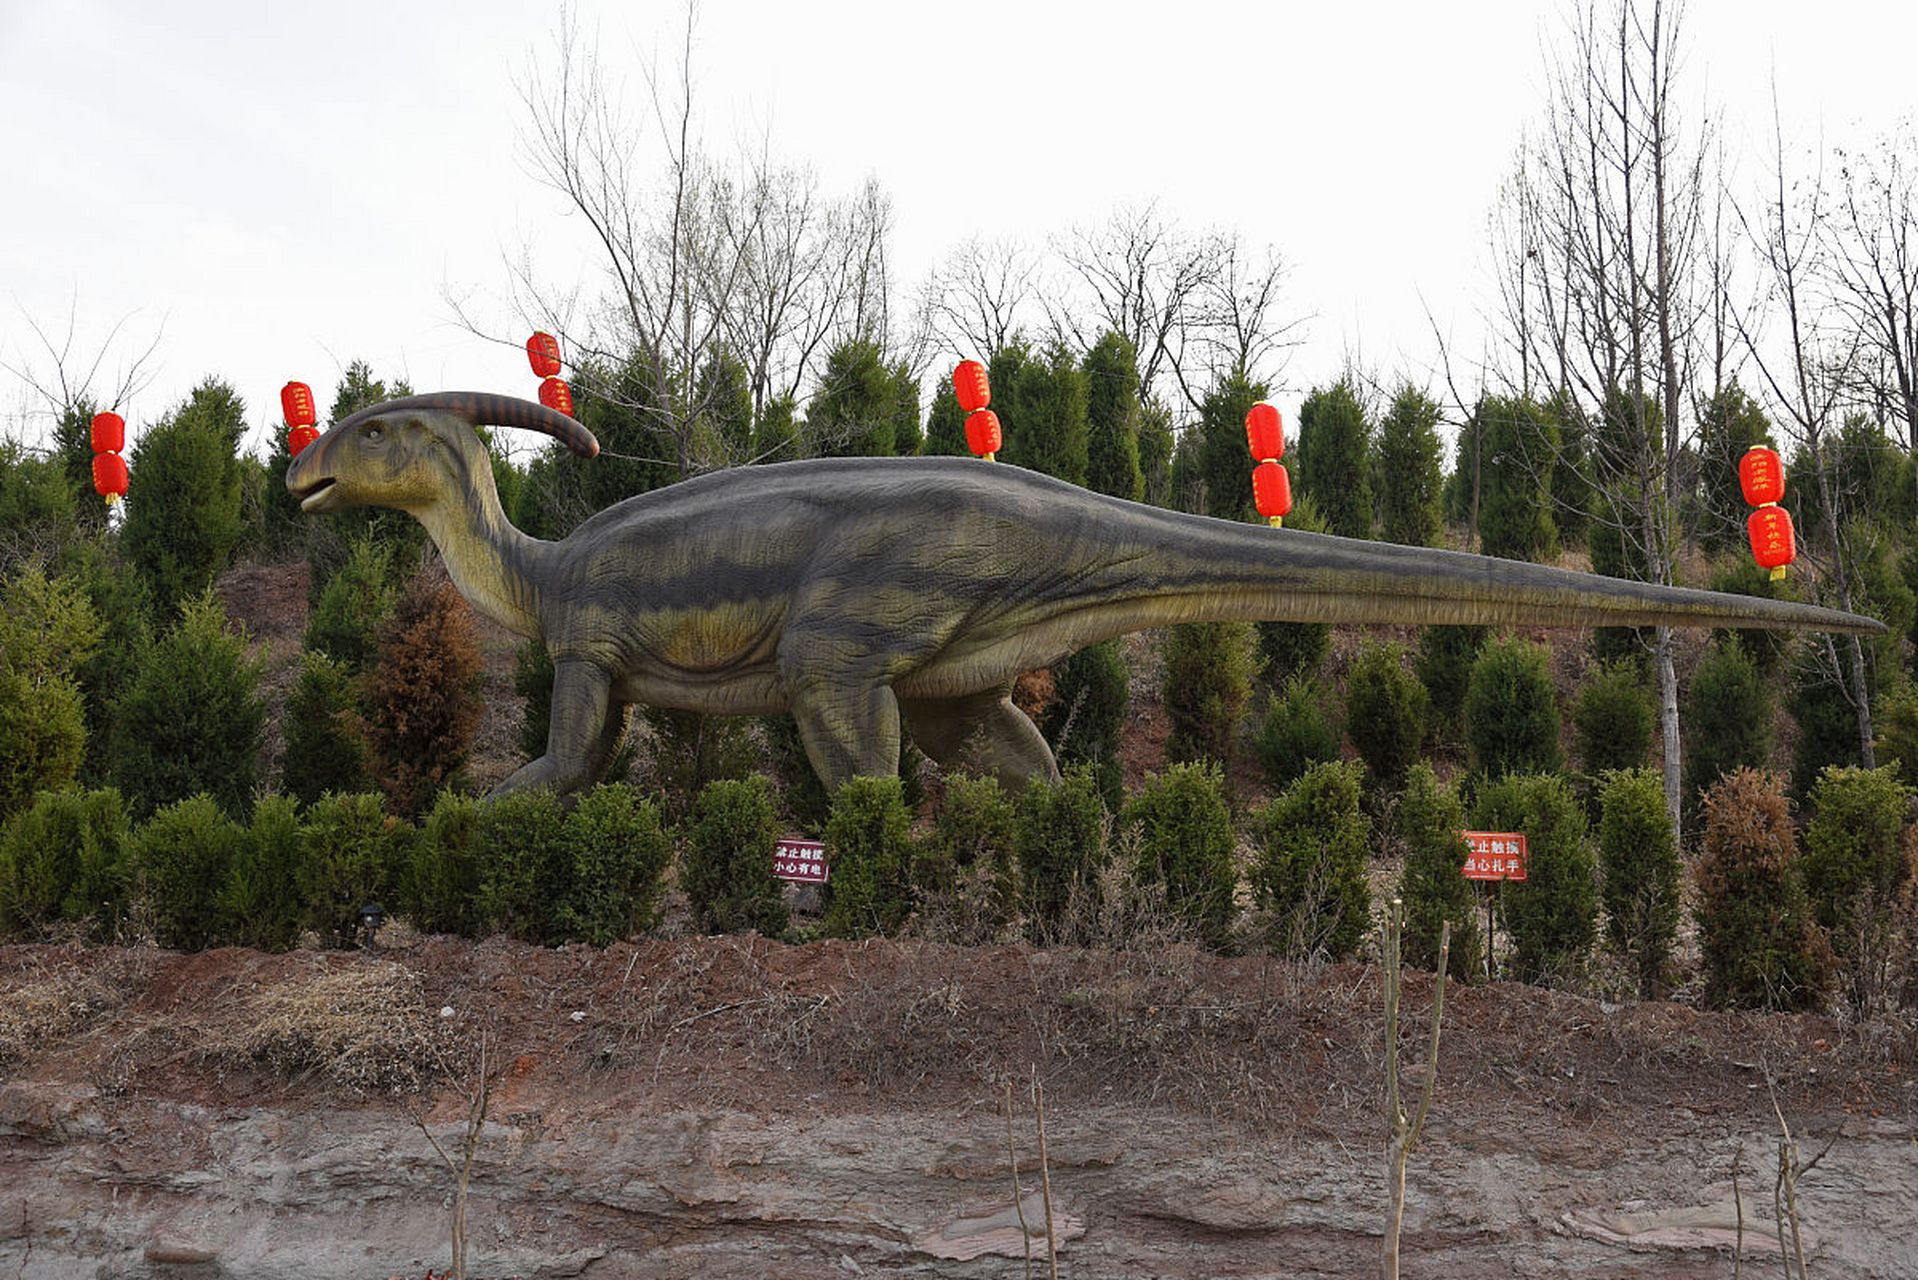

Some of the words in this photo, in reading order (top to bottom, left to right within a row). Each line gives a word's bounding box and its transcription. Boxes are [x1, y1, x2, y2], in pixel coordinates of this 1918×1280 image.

[773, 861, 821, 875] 小心有电
[1463, 858, 1520, 873] 当心扎手
